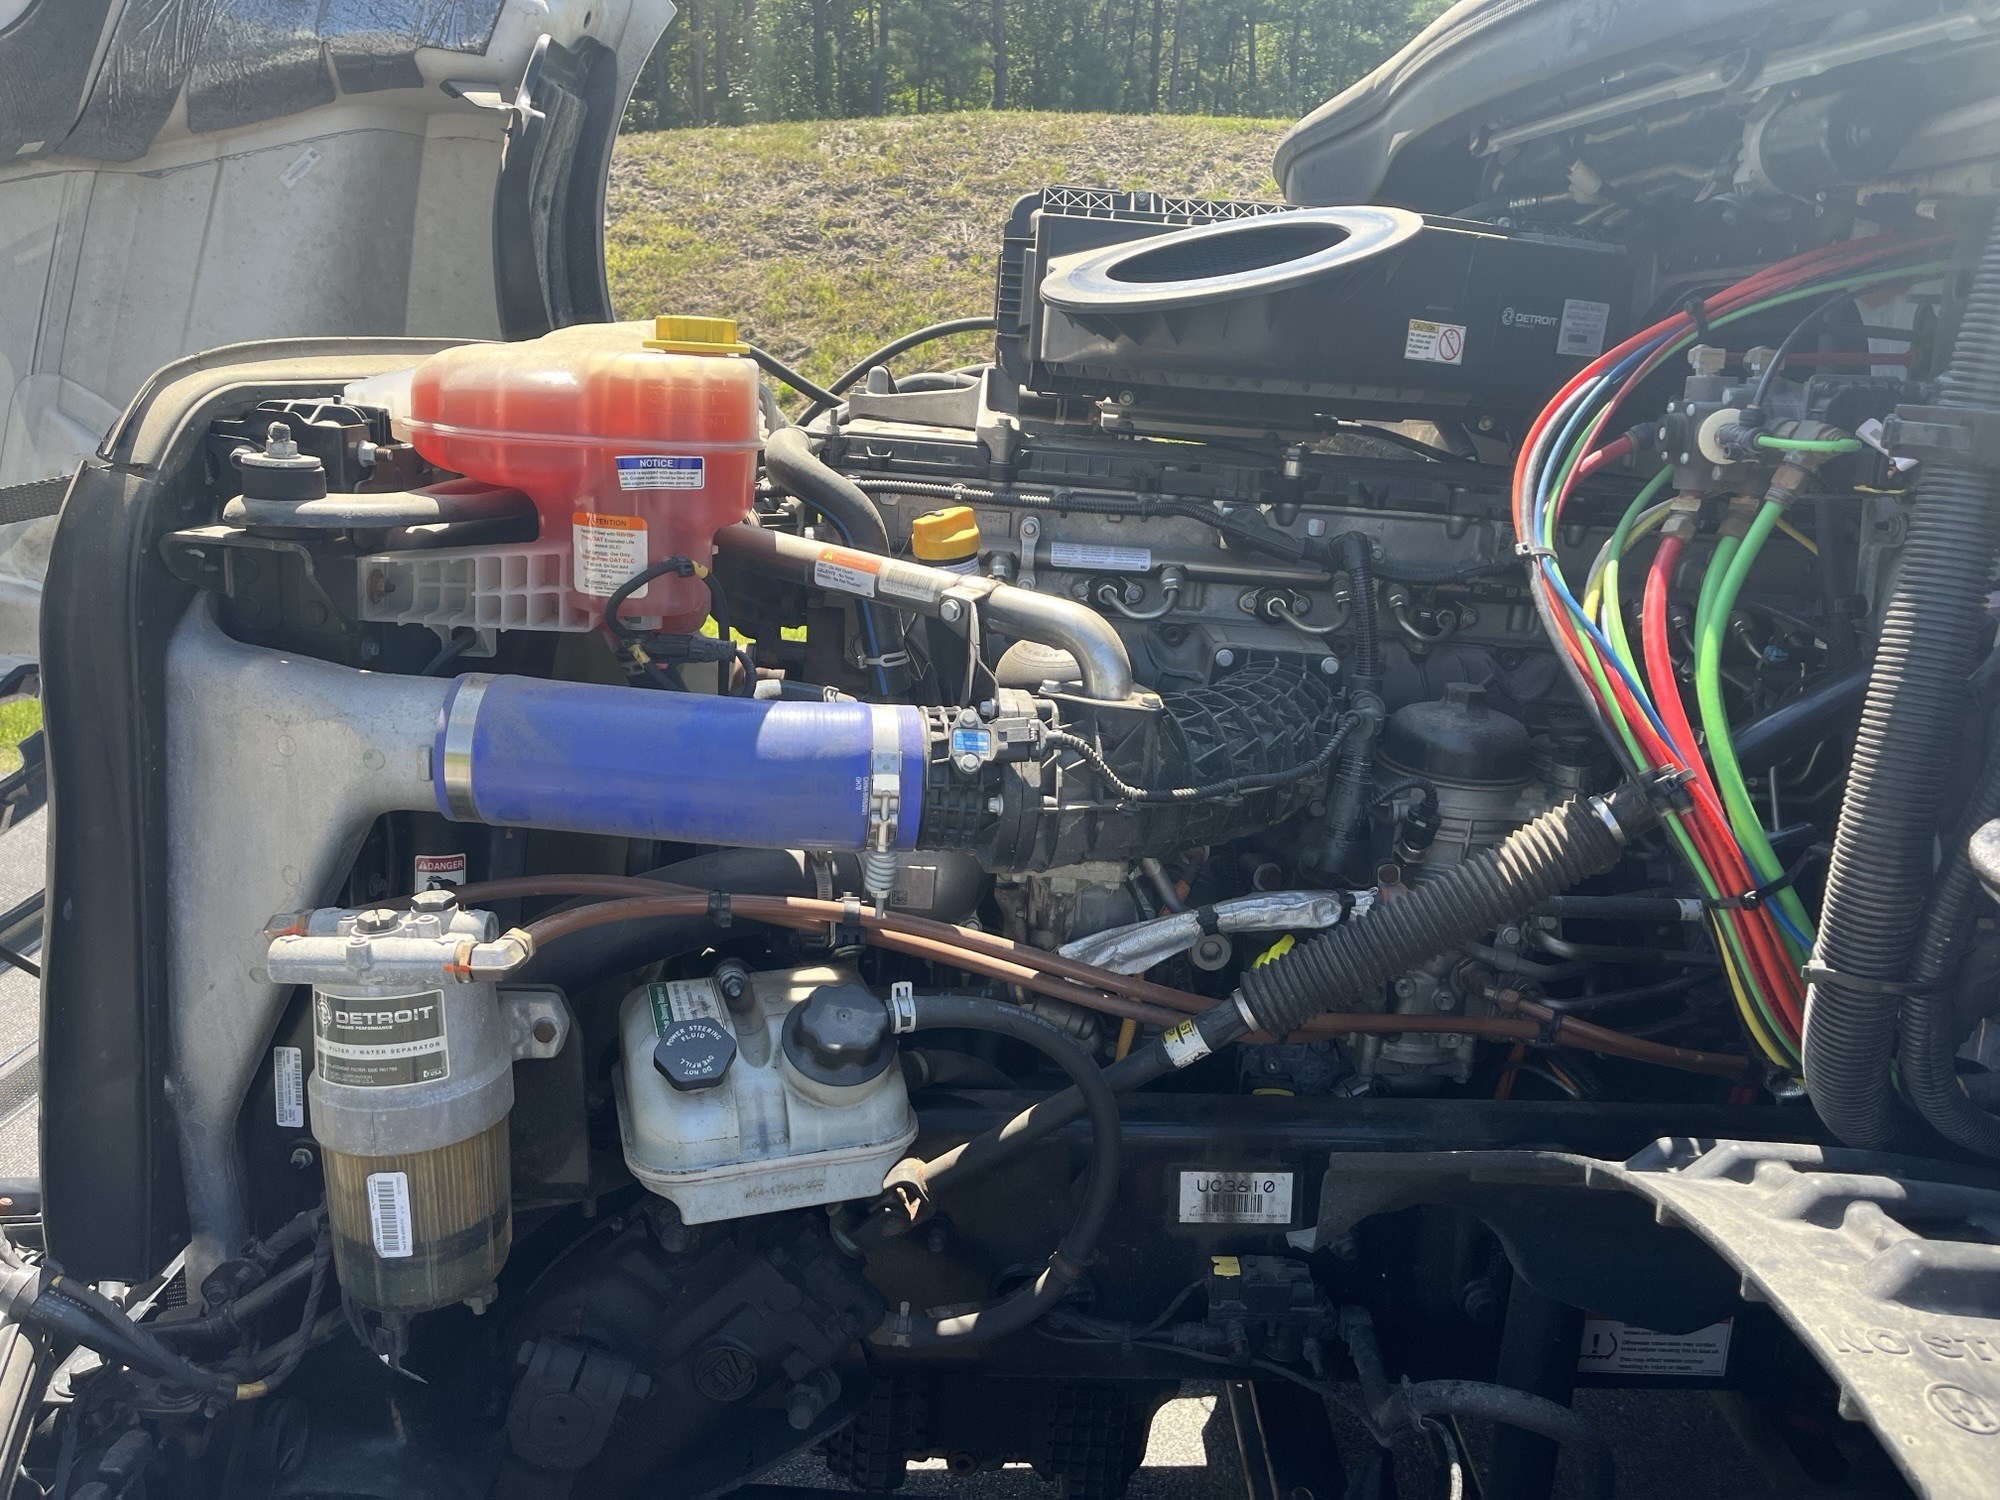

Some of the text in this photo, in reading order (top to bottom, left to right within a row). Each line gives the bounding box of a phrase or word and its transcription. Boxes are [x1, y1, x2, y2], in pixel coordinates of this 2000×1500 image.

[1515, 313, 1558, 326] DETROIT
[640, 459, 674, 467] NOTICE
[428, 860, 463, 870] DANGER
[335, 1005, 434, 1025] DETROIT
[666, 1028, 686, 1047] POWER
[688, 1025, 722, 1040] STEERING
[680, 1032, 706, 1042] FLUID
[329, 1045, 350, 1054] FILTER
[391, 1041, 441, 1054] SEPARATOR
[680, 1054, 714, 1069] OVERFILL
[702, 1065, 713, 1073] DO
[1819, 1325, 2000, 1362] NO ST
